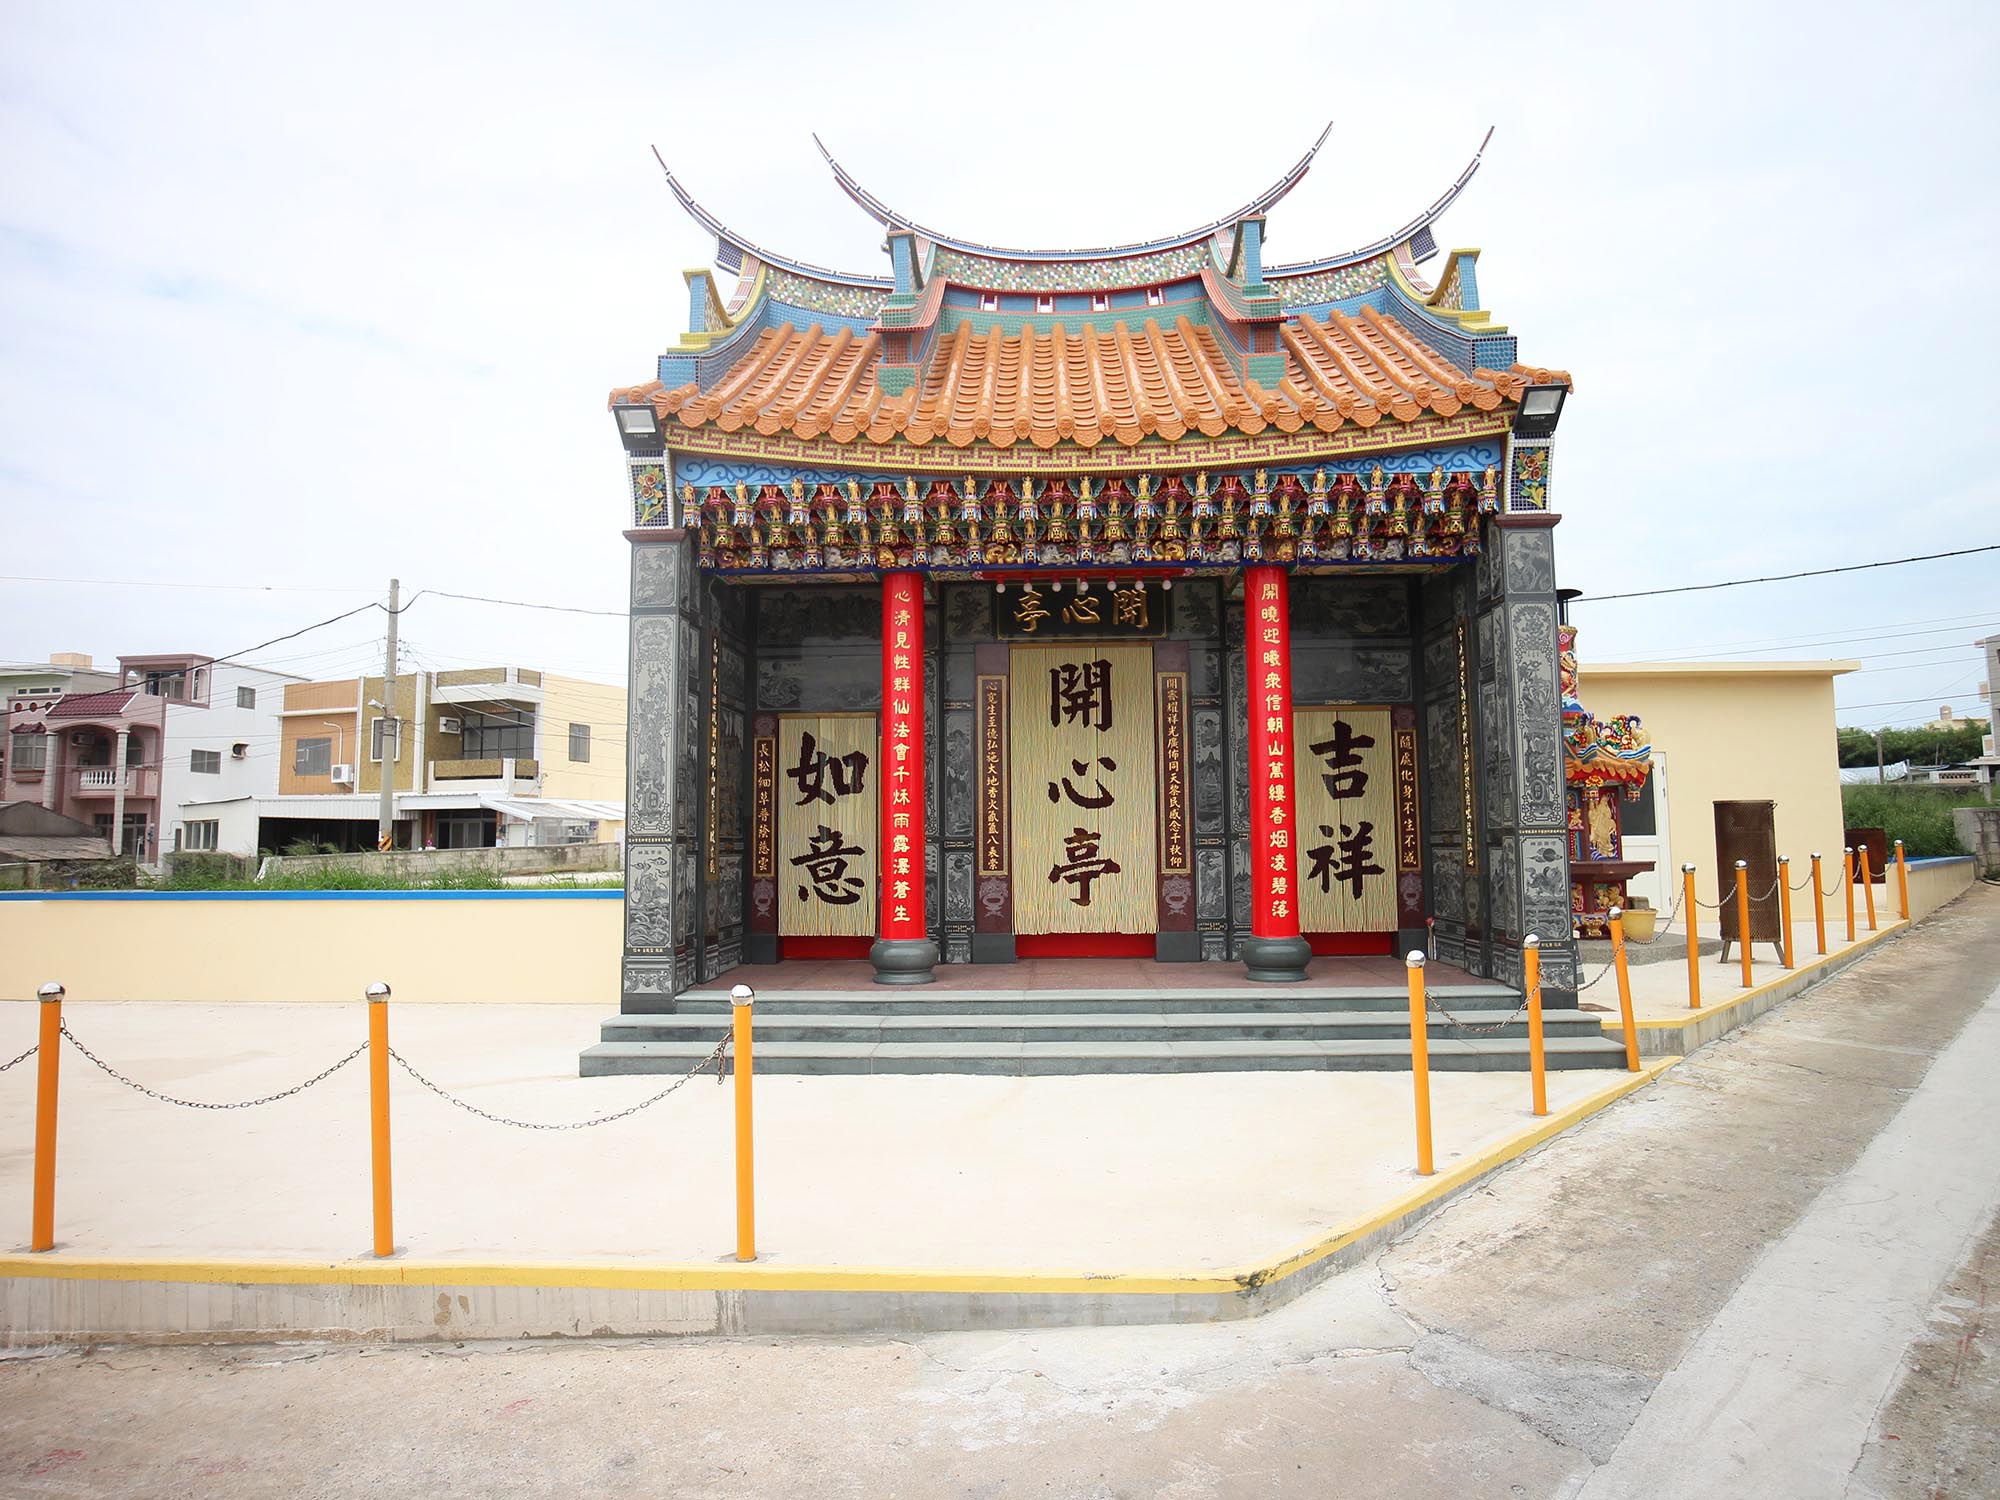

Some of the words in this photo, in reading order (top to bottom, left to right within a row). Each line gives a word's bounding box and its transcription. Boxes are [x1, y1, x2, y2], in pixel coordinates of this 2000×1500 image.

[1013, 589, 1149, 632] 開心亭
[786, 731, 869, 905] 如意
[1048, 659, 1121, 906] 開心亭
[1306, 720, 1385, 900] 吉祥
